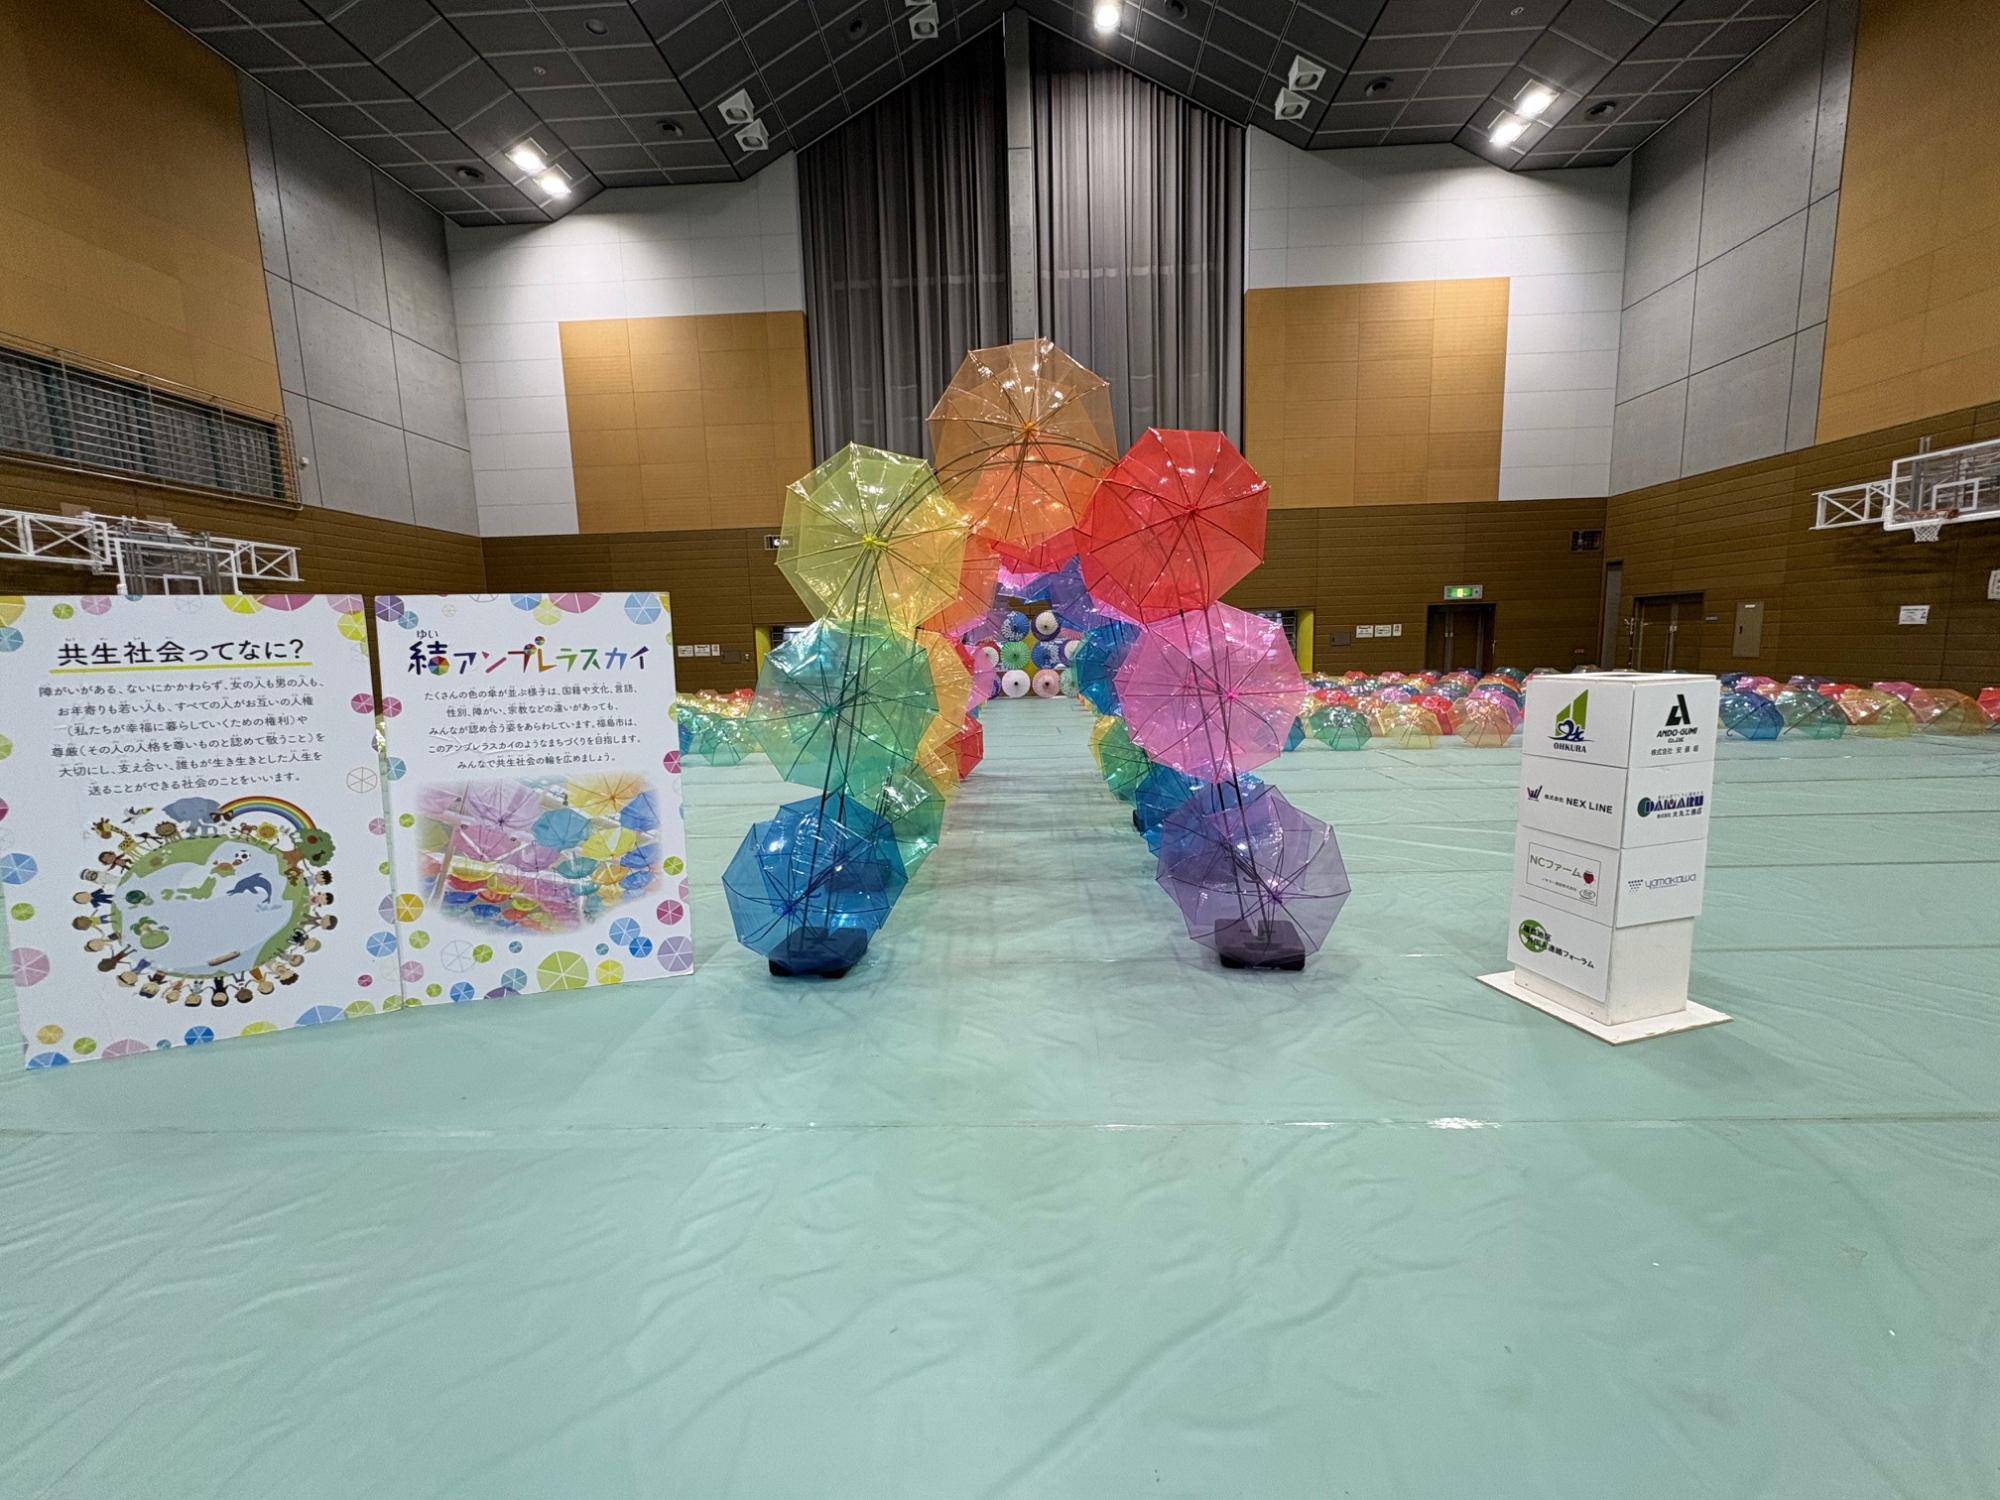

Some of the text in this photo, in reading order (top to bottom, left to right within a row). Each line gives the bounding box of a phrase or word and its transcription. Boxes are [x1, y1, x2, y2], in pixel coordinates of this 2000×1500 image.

[416, 630, 439, 639] ゆい
[58, 639, 304, 666] 共生社会ってなに？
[1553, 742, 1587, 753] OHKURA
[1566, 797, 1587, 809] NEX
[1588, 802, 1613, 814] LINE
